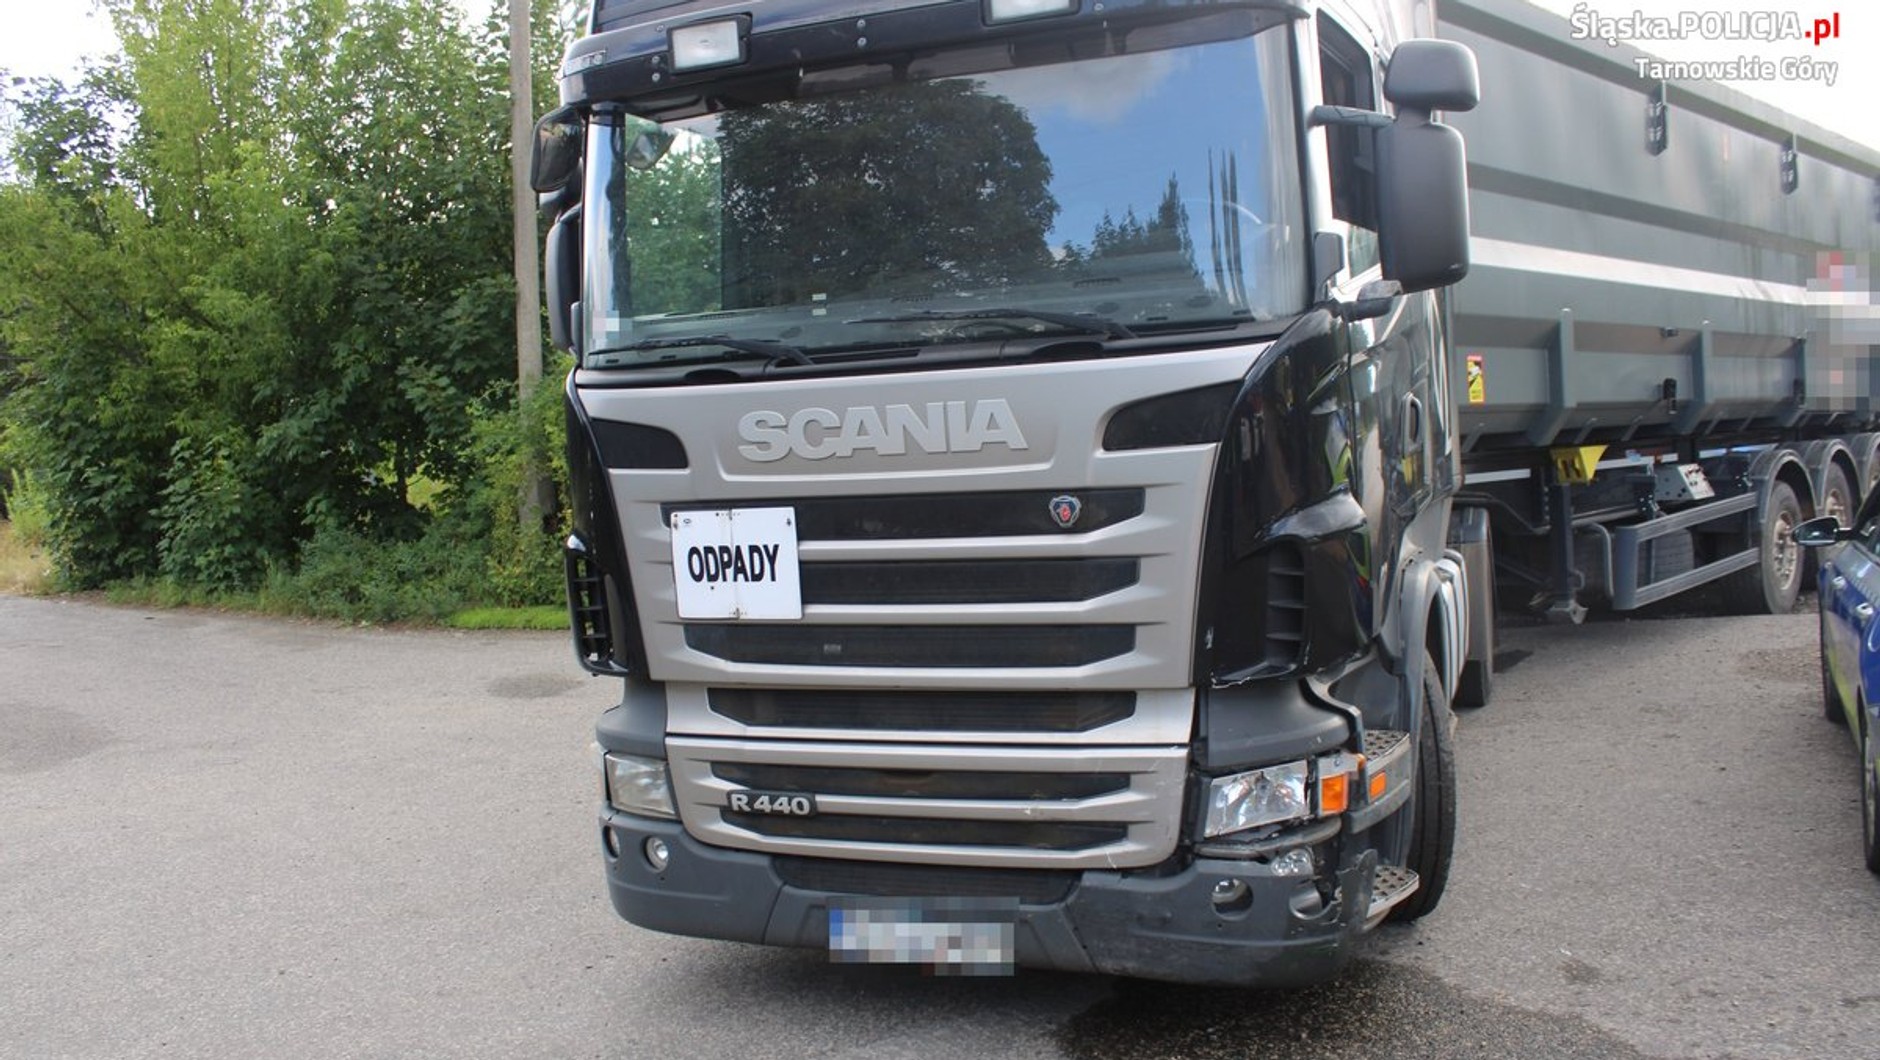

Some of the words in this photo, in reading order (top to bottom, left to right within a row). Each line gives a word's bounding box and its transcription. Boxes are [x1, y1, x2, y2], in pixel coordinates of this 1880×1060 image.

[737, 397, 1029, 463] SCANIA
[687, 543, 780, 583] ODPADY
[730, 793, 752, 812] R
[753, 794, 811, 816] 440
